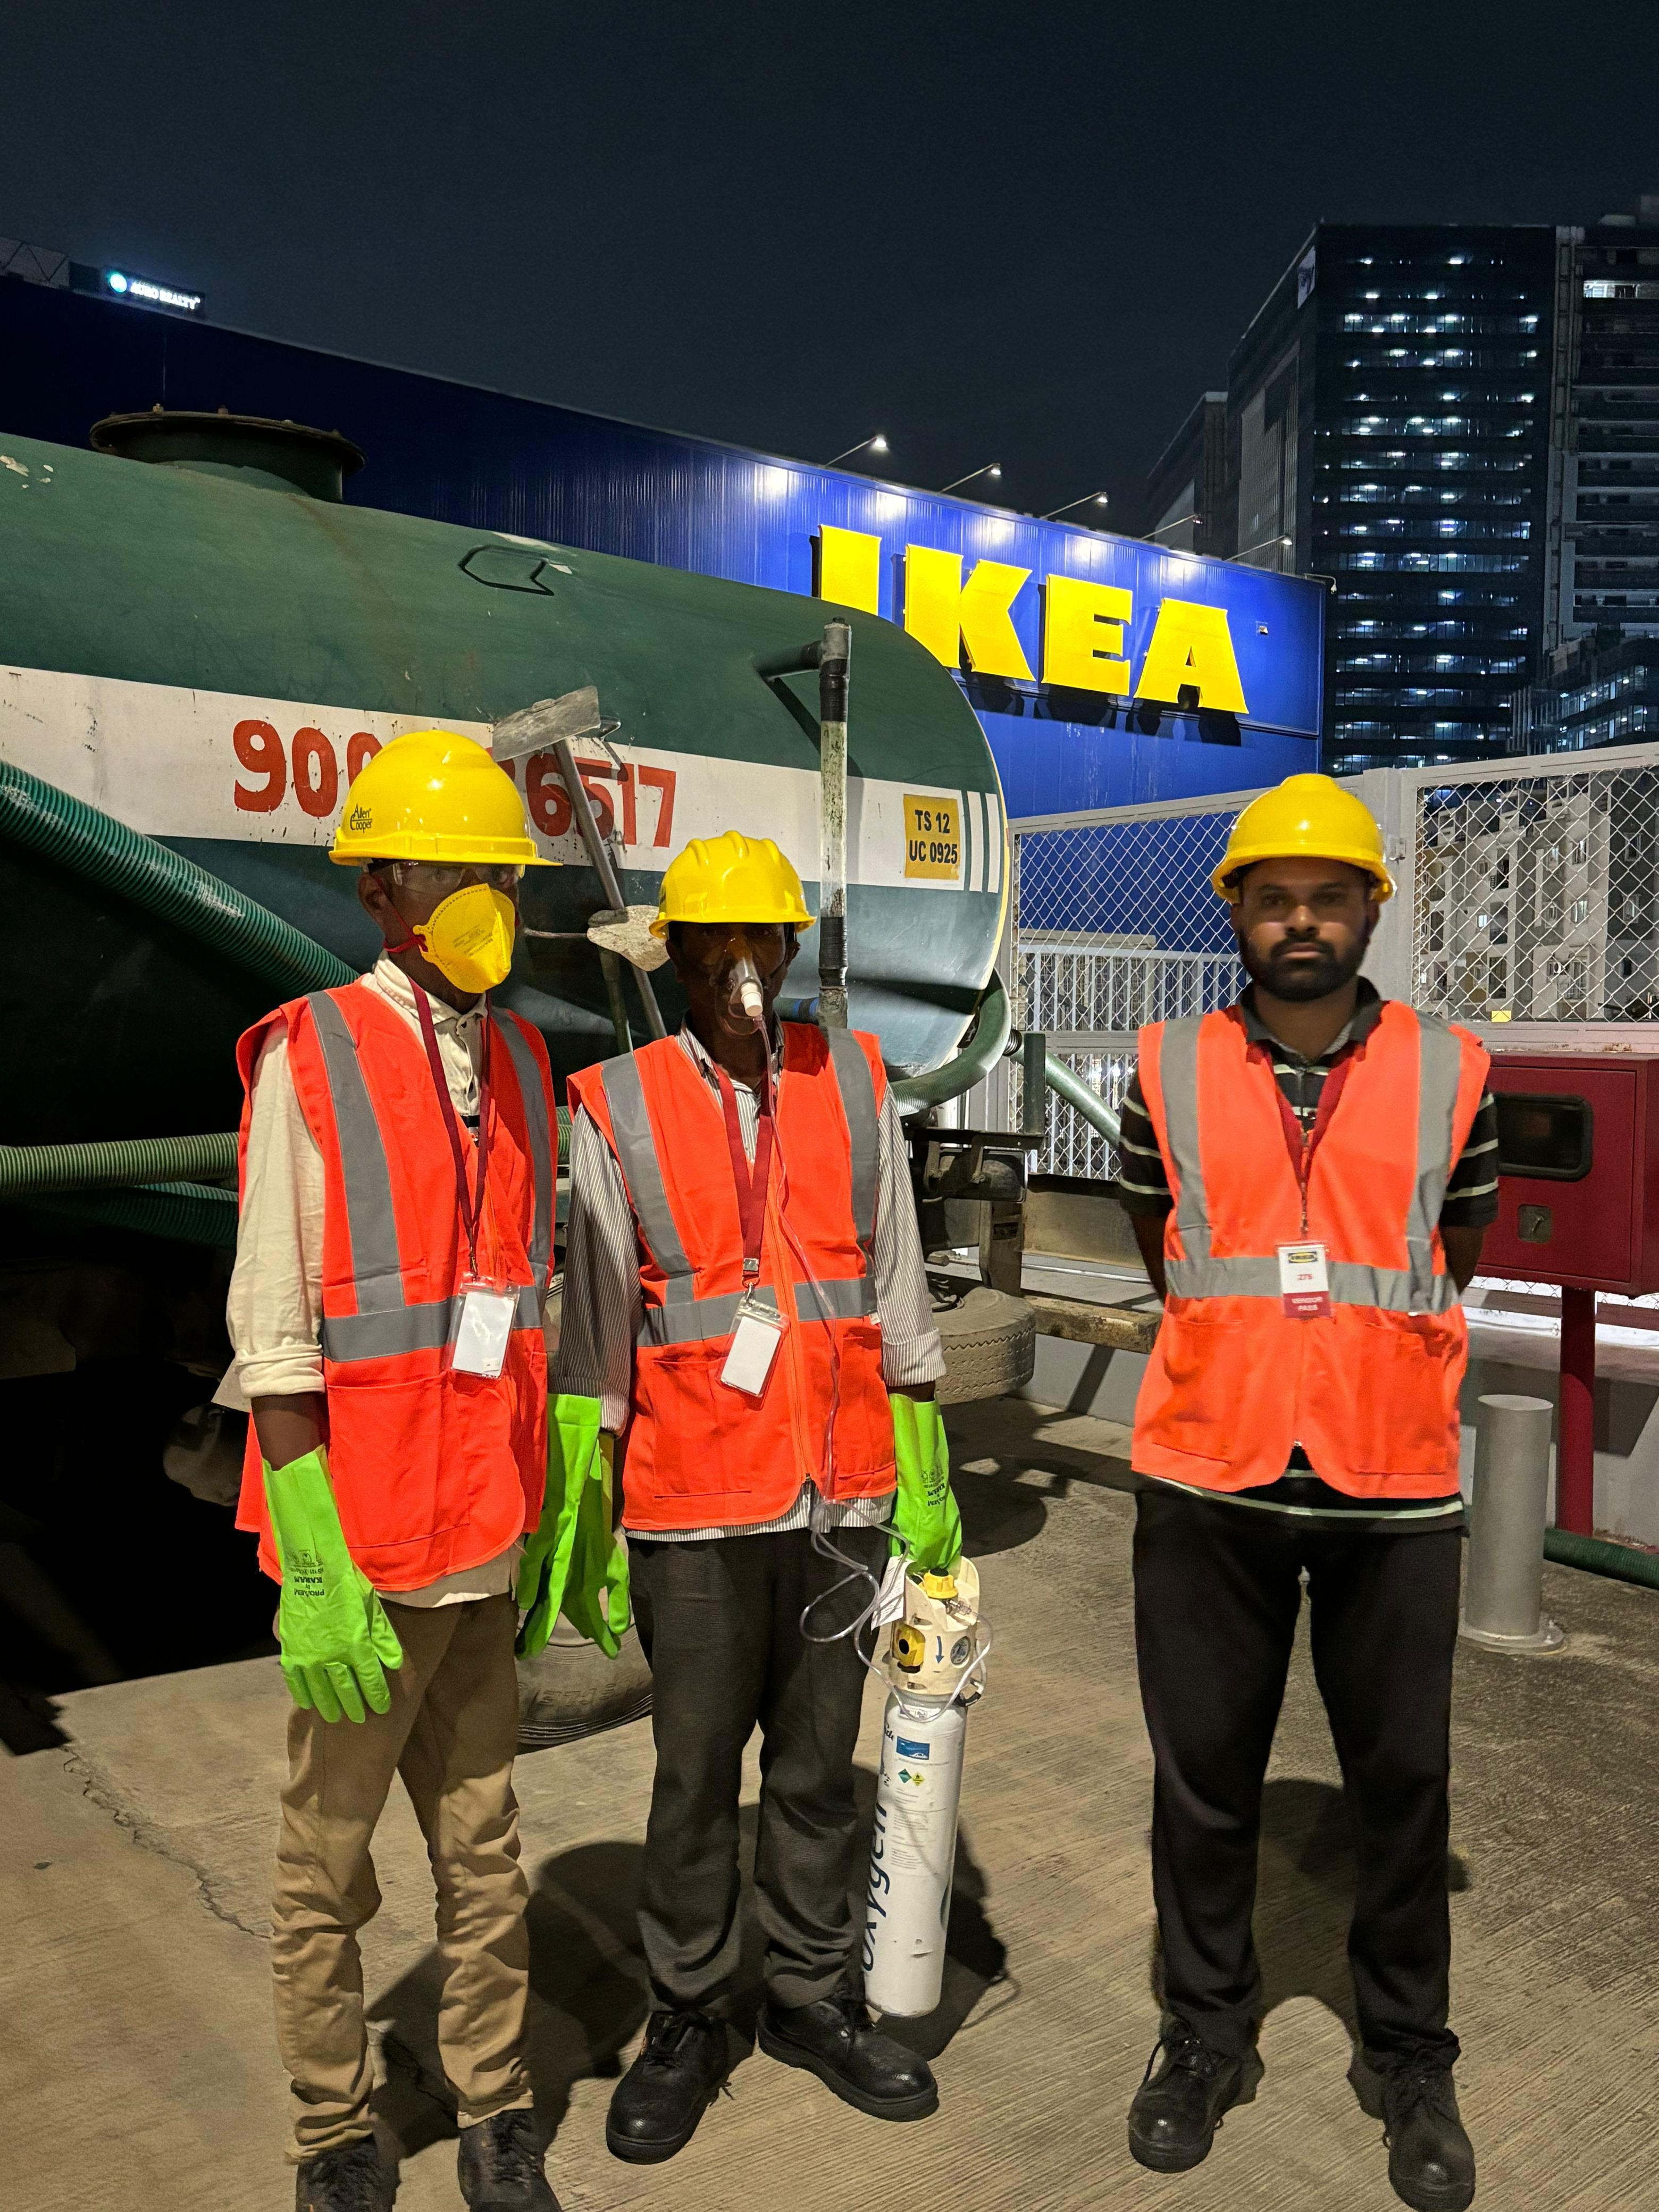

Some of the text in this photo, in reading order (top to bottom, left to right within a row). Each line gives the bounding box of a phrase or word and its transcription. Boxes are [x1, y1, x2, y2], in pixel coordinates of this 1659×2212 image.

[819, 523, 1250, 714] IKEA
[354, 802, 370, 819] Allen
[915, 809, 950, 834] TS 12
[350, 813, 372, 834] Cooper
[909, 840, 958, 864] UC 0925
